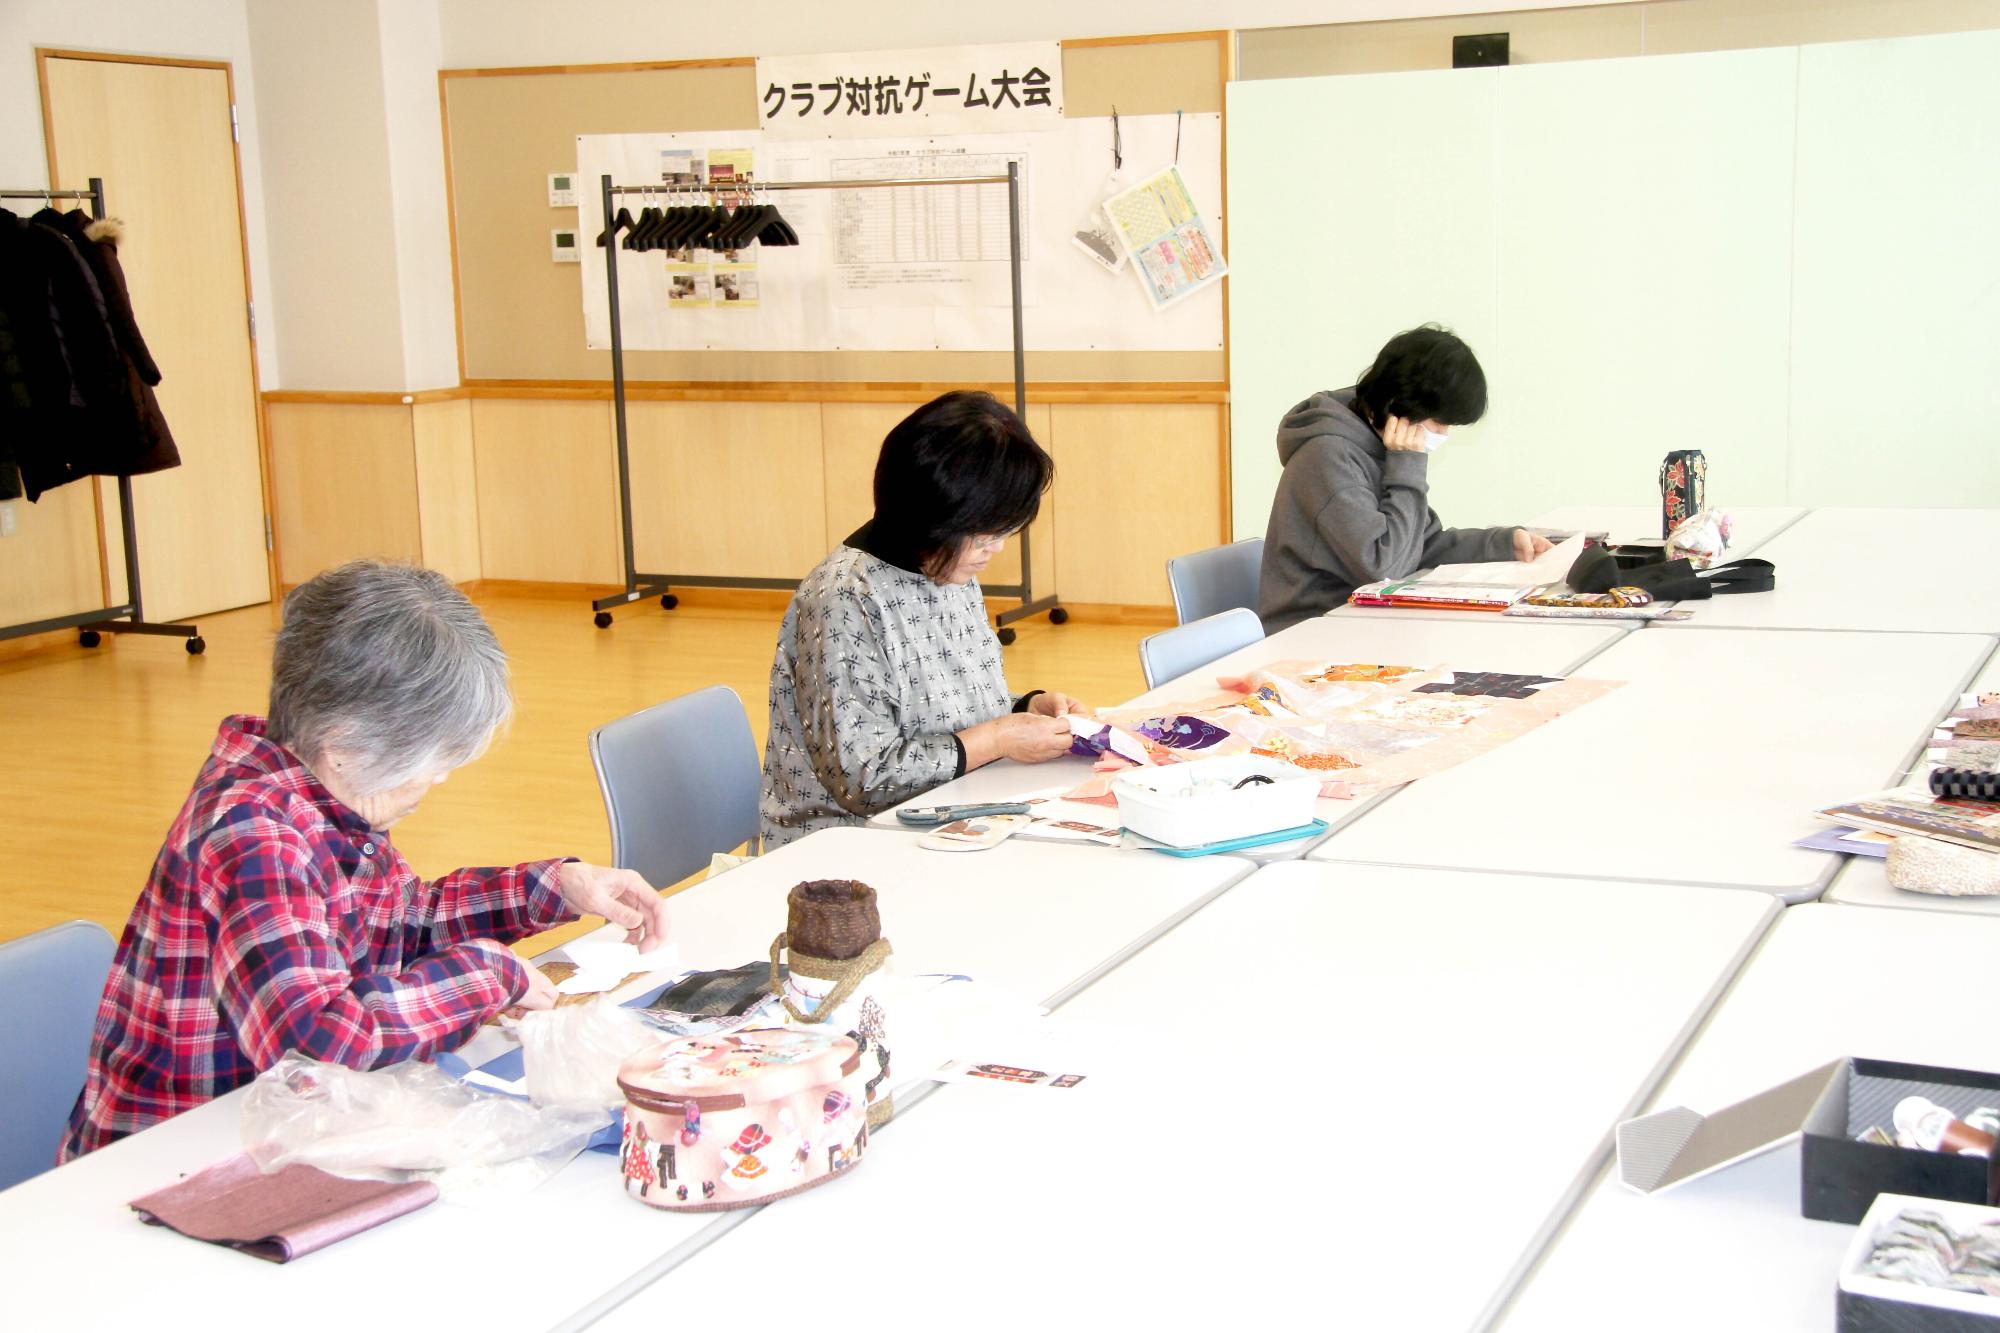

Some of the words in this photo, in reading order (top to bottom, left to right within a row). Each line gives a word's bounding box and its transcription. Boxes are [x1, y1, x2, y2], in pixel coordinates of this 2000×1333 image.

[763, 66, 1052, 119] クラブ対抗ゲーム大会
